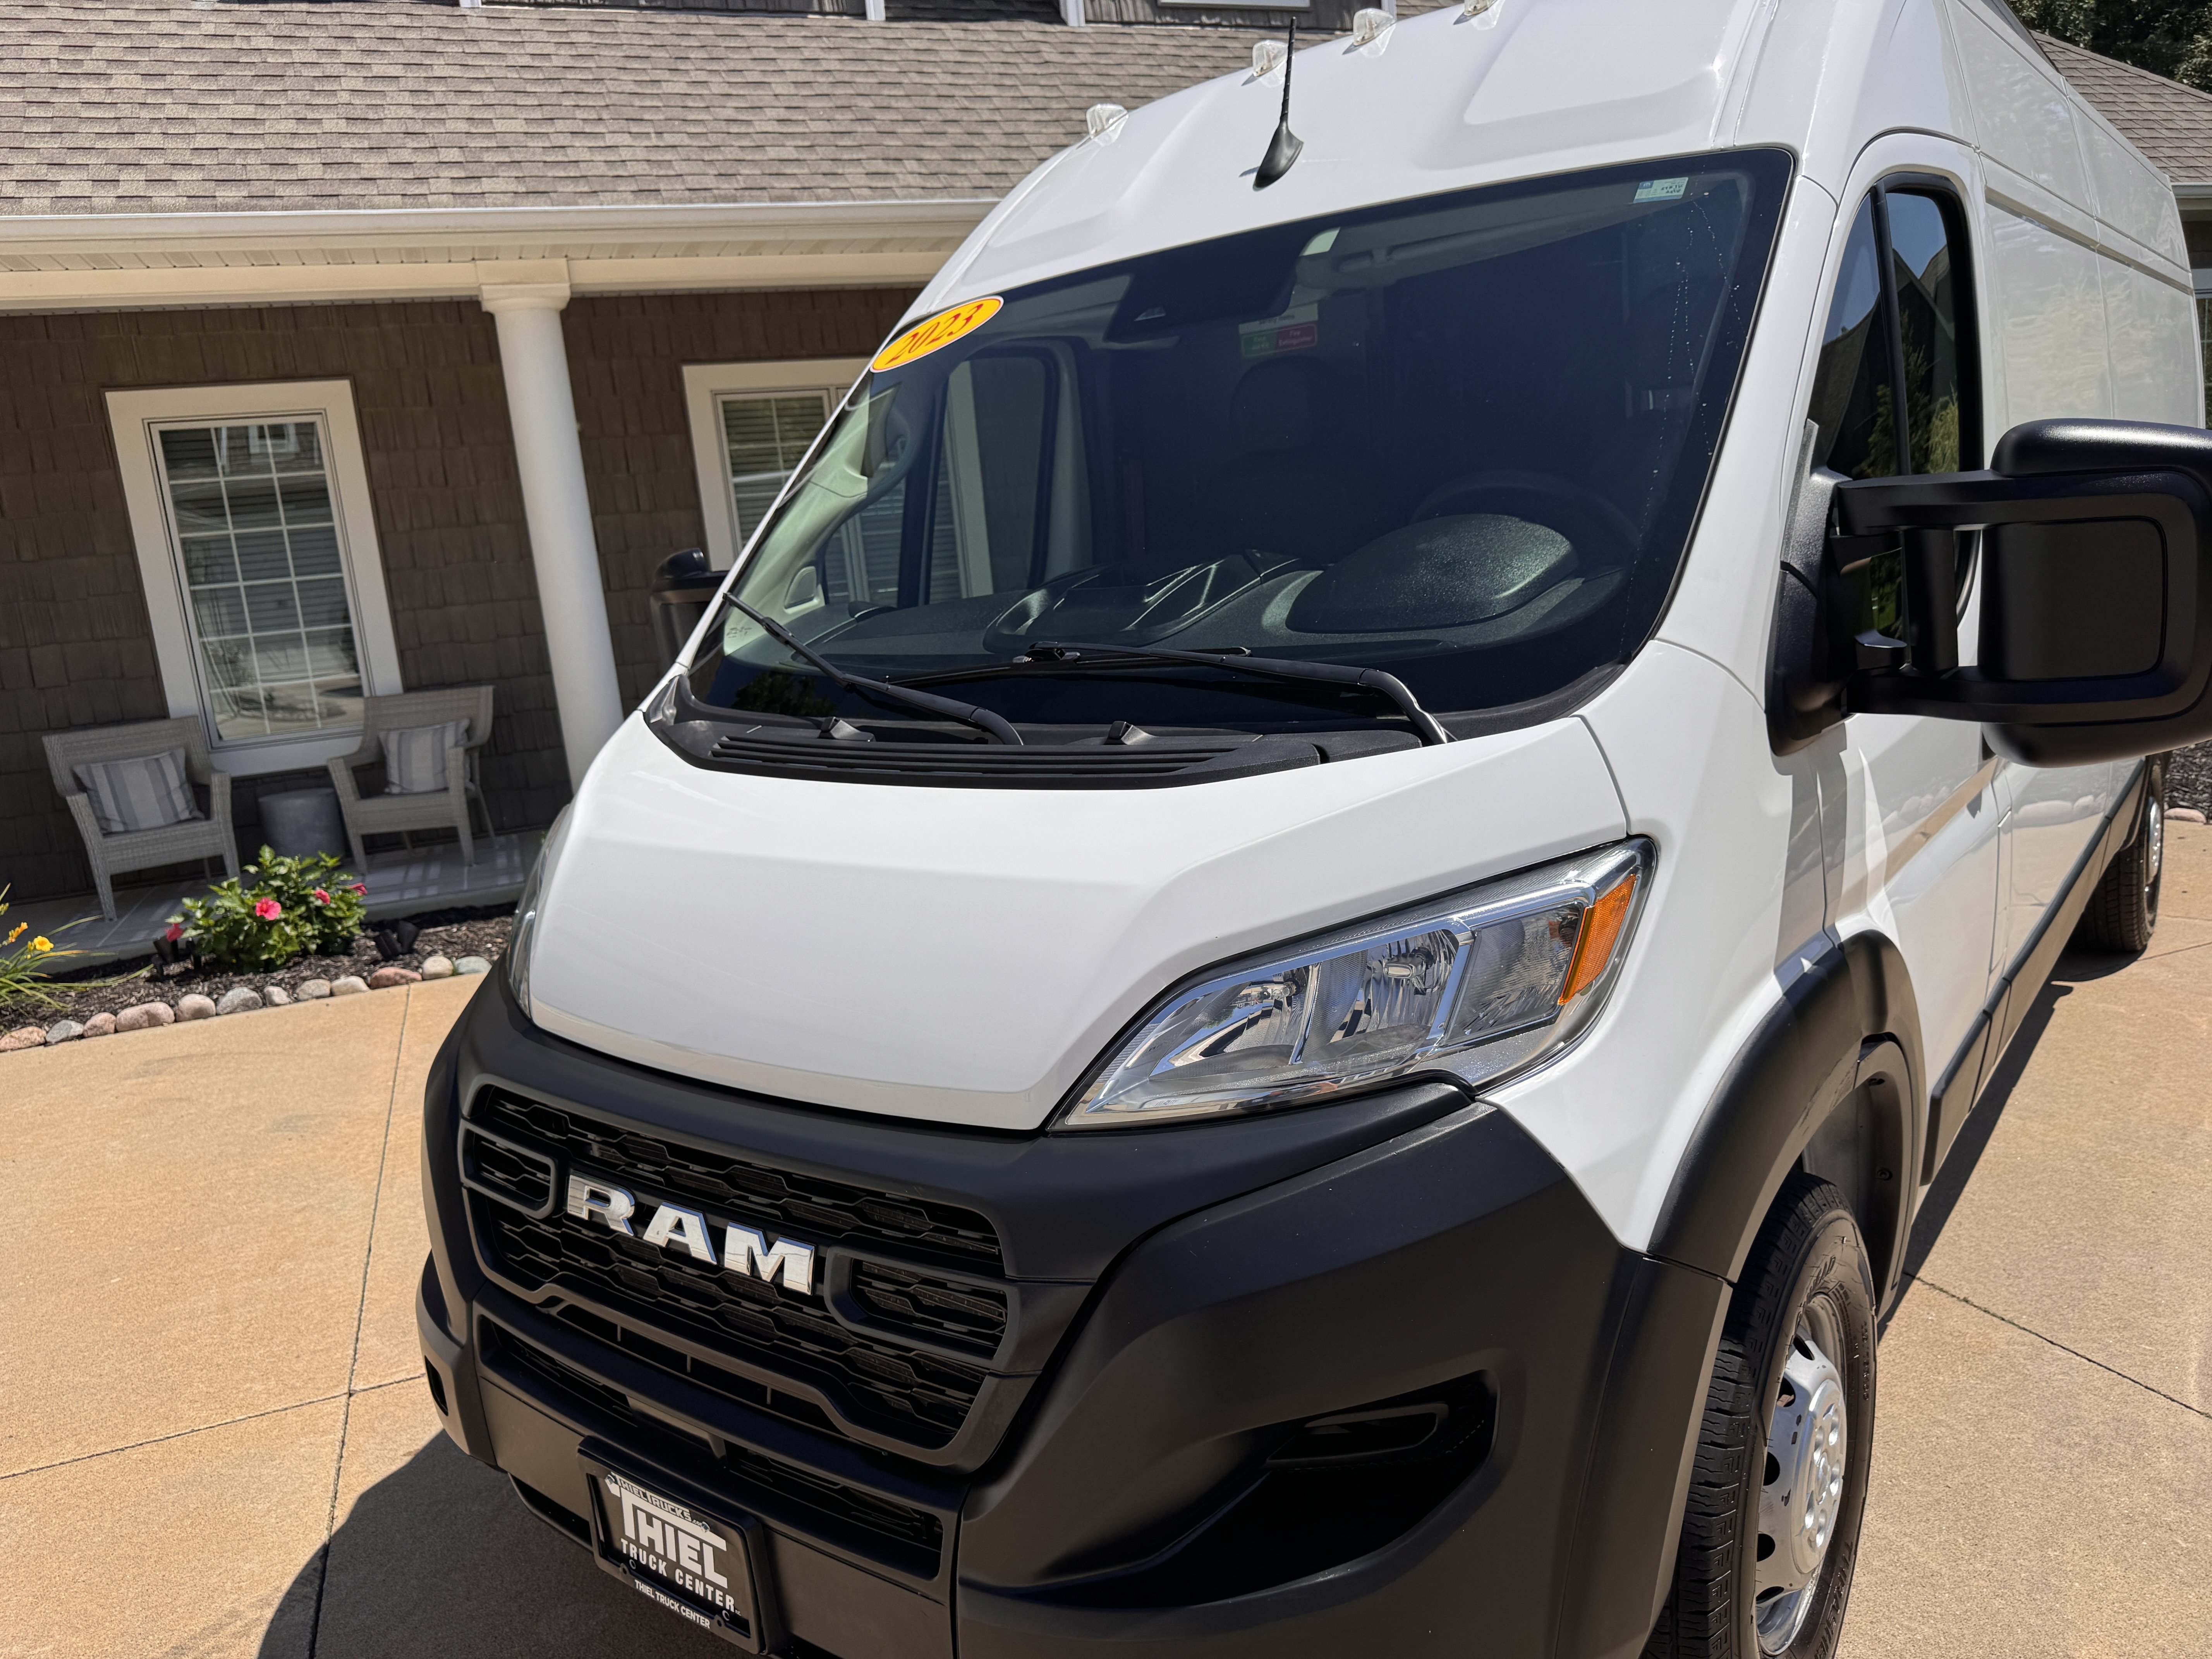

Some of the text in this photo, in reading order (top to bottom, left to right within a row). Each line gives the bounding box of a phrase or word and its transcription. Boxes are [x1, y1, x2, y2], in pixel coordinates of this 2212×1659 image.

[884, 303, 984, 365] 2023
[567, 1174, 816, 1296] RAM
[606, 1478, 728, 1588] THIEL
[611, 1472, 702, 1526] THIELTRUCKS.co
[621, 1538, 735, 1613] TRUCK CENTER
[634, 1579, 710, 1629] THIEL TRUCK CENTER
